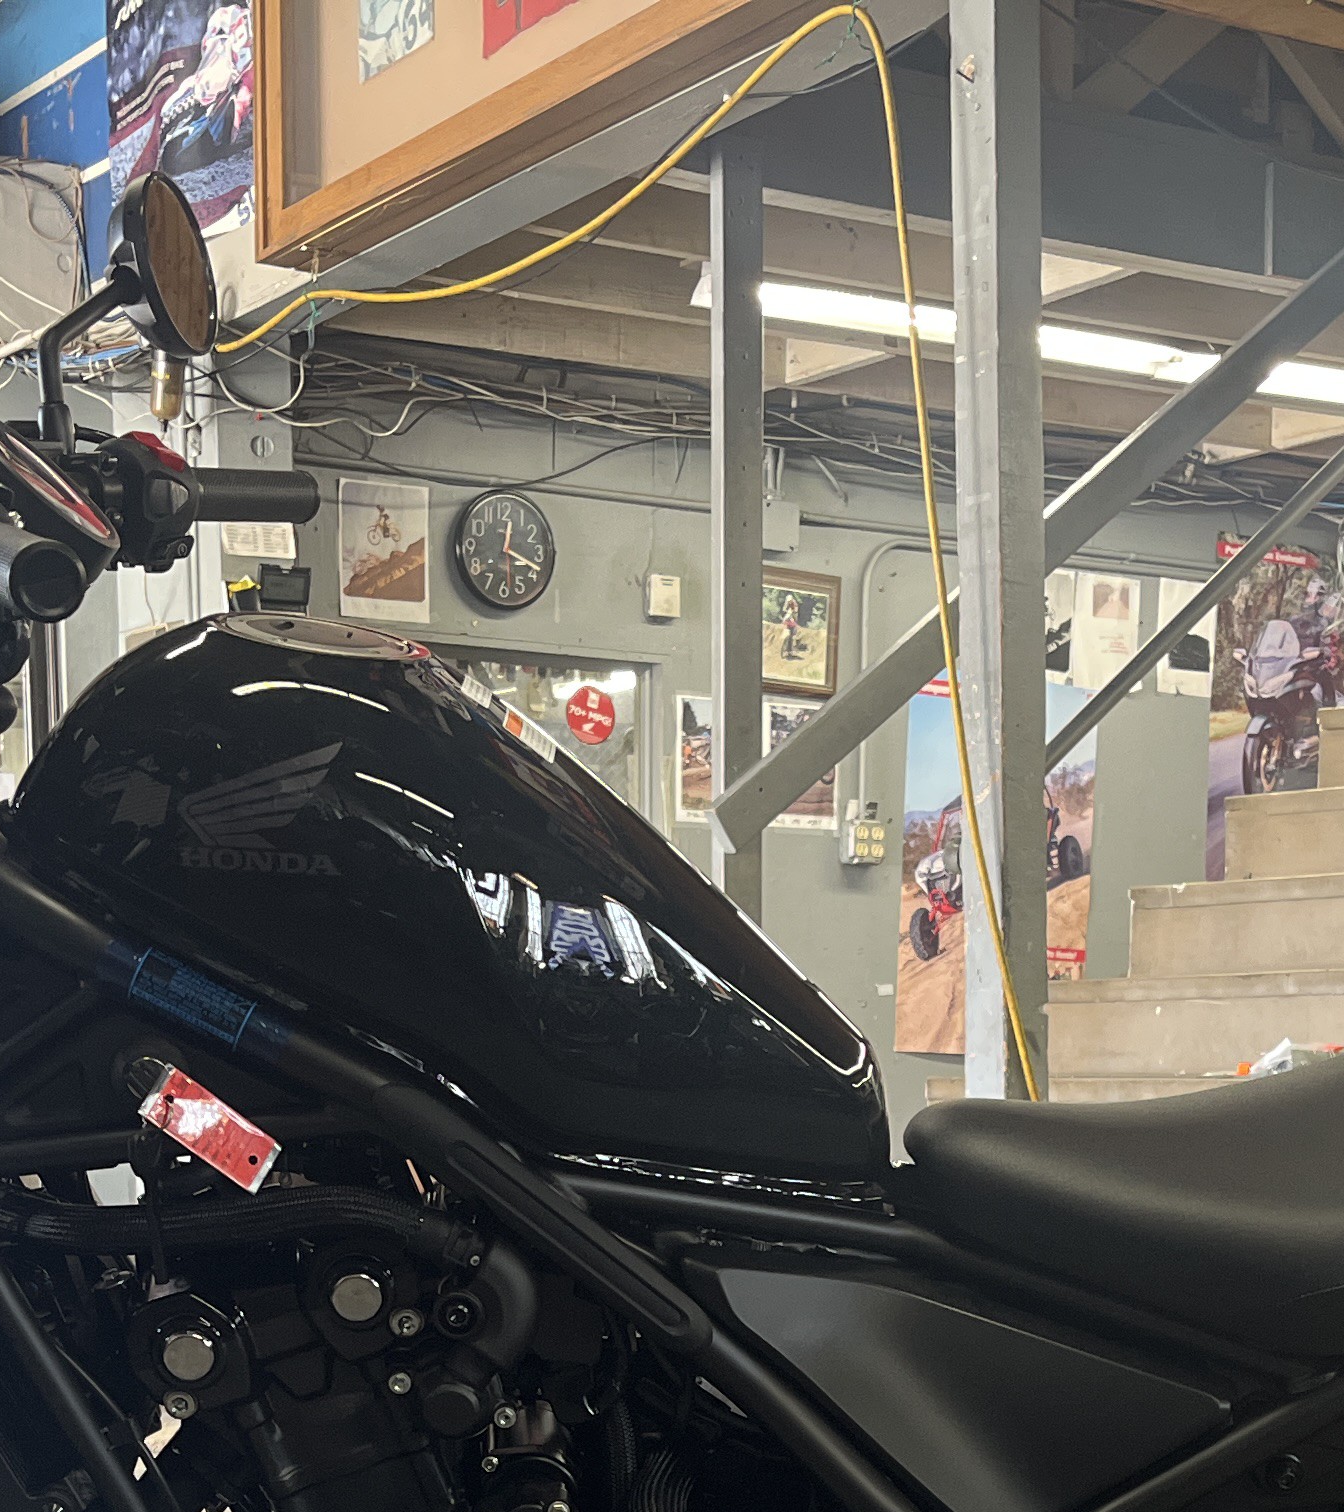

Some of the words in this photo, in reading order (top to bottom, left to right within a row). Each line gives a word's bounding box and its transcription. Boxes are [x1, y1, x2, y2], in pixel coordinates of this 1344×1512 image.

[484, 506, 493, 524] 11
[497, 502, 511, 521] 12
[519, 508, 525, 527] 1
[471, 518, 485, 537] 10
[527, 524, 538, 543] 2
[465, 537, 476, 555] 9
[533, 544, 544, 563] 3
[470, 557, 481, 575] 8
[528, 569, 538, 582] 4
[484, 572, 494, 590] 7
[498, 580, 510, 598] 6
[514, 575, 526, 594] 5
[179, 848, 342, 876] HONDA
